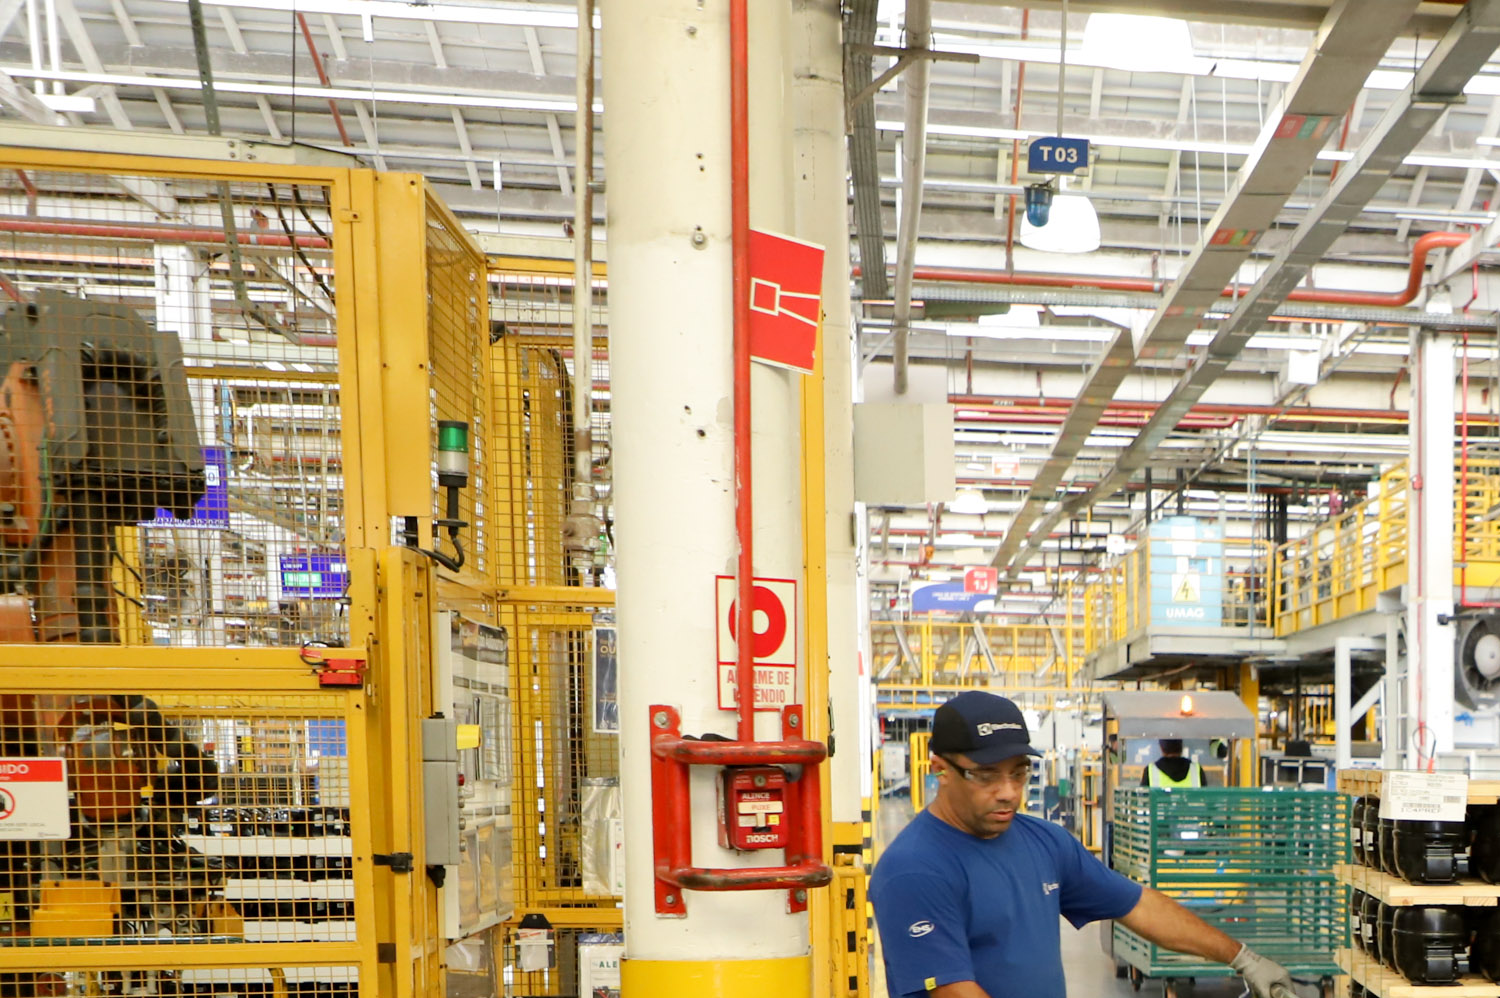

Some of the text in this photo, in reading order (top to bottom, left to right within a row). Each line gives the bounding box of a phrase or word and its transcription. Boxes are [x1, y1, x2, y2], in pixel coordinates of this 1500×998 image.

[1039, 145, 1078, 164] T 03
[1166, 607, 1205, 618] UMAG
[777, 671, 790, 685] DE
